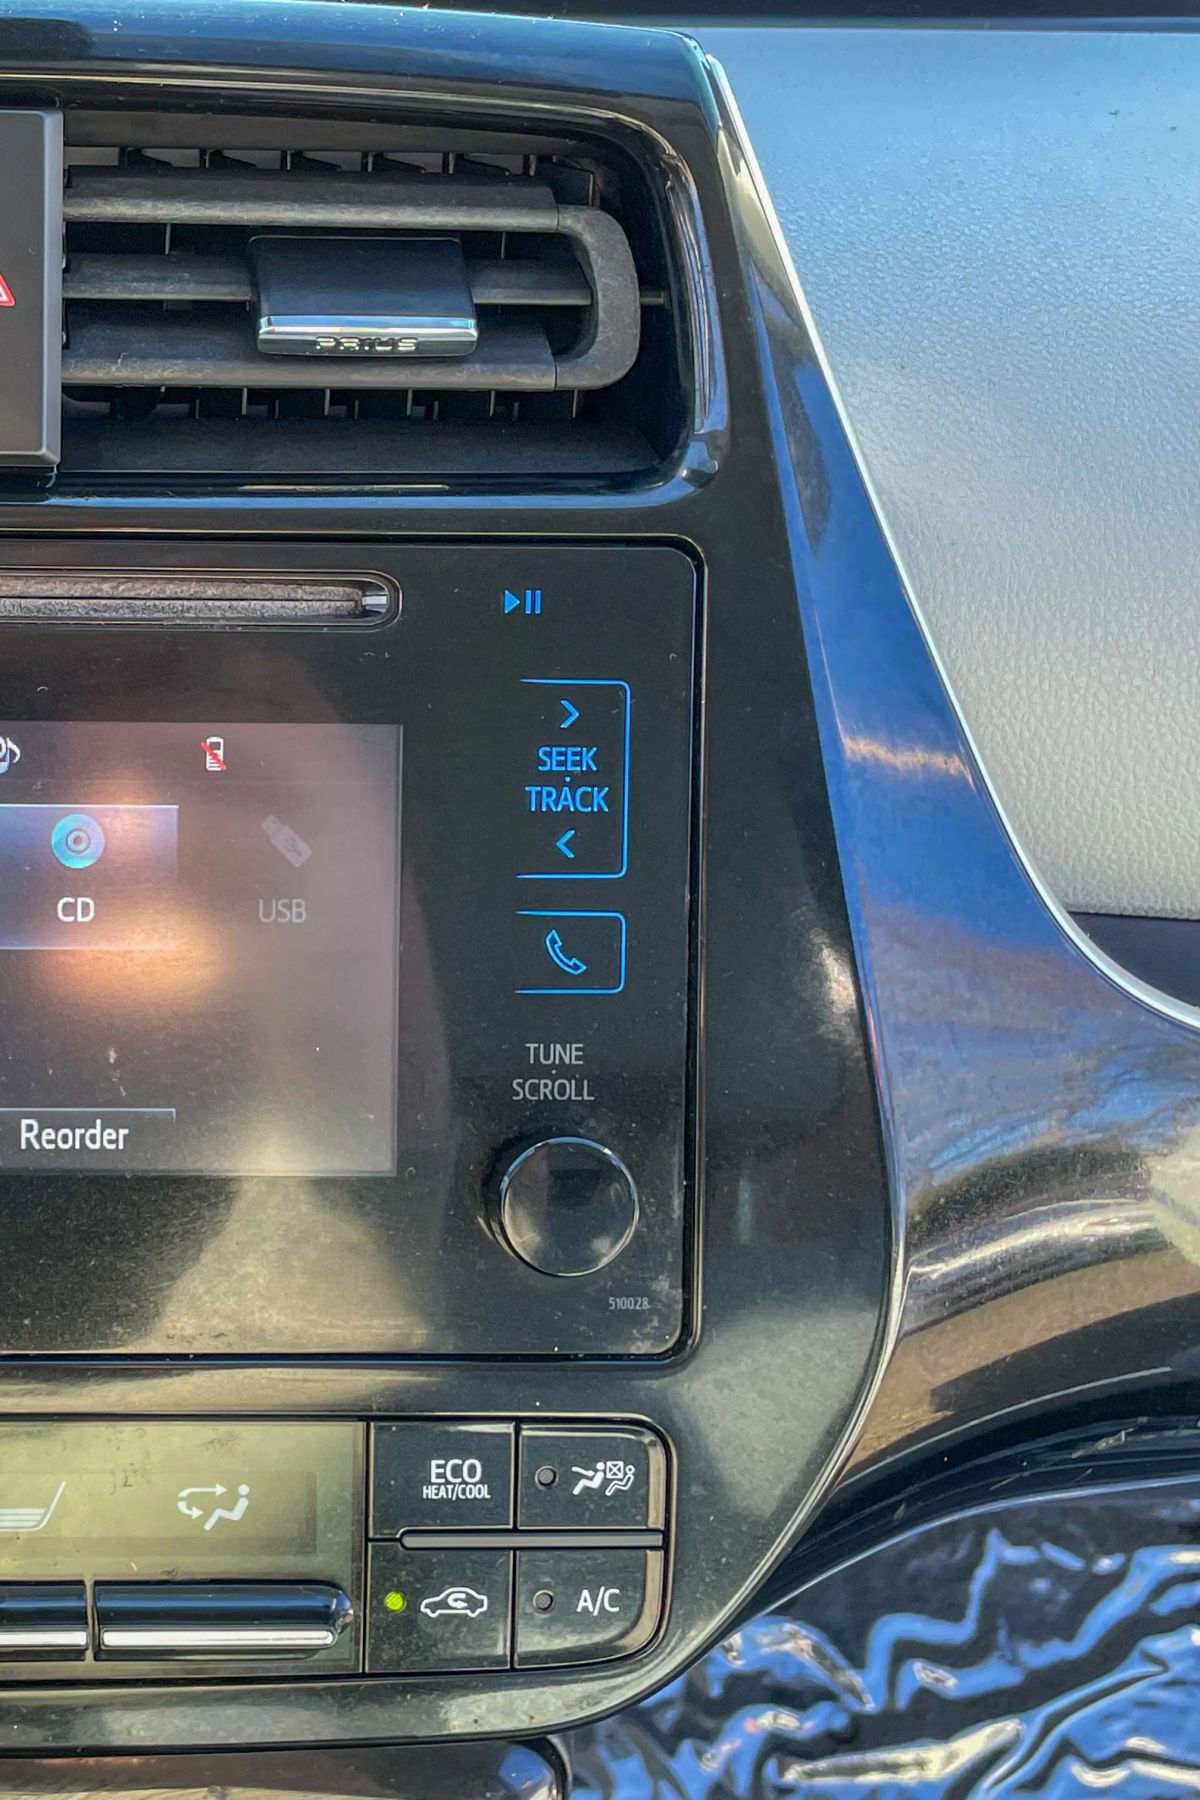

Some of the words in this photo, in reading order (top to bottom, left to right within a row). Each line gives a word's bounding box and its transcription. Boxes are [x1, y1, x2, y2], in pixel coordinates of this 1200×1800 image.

[537, 745, 598, 772] SEEK
[524, 785, 610, 813] TRACK
[56, 896, 96, 923] CD
[257, 898, 308, 924] USB
[524, 1043, 585, 1066] TUNE
[511, 1078, 596, 1102] SCROLL
[19, 1118, 130, 1151] Reorder
[608, 1296, 650, 1311] 510028
[430, 1458, 482, 1484] ECO
[422, 1483, 492, 1501] HEAT/COOL
[576, 1587, 622, 1615] A/C
